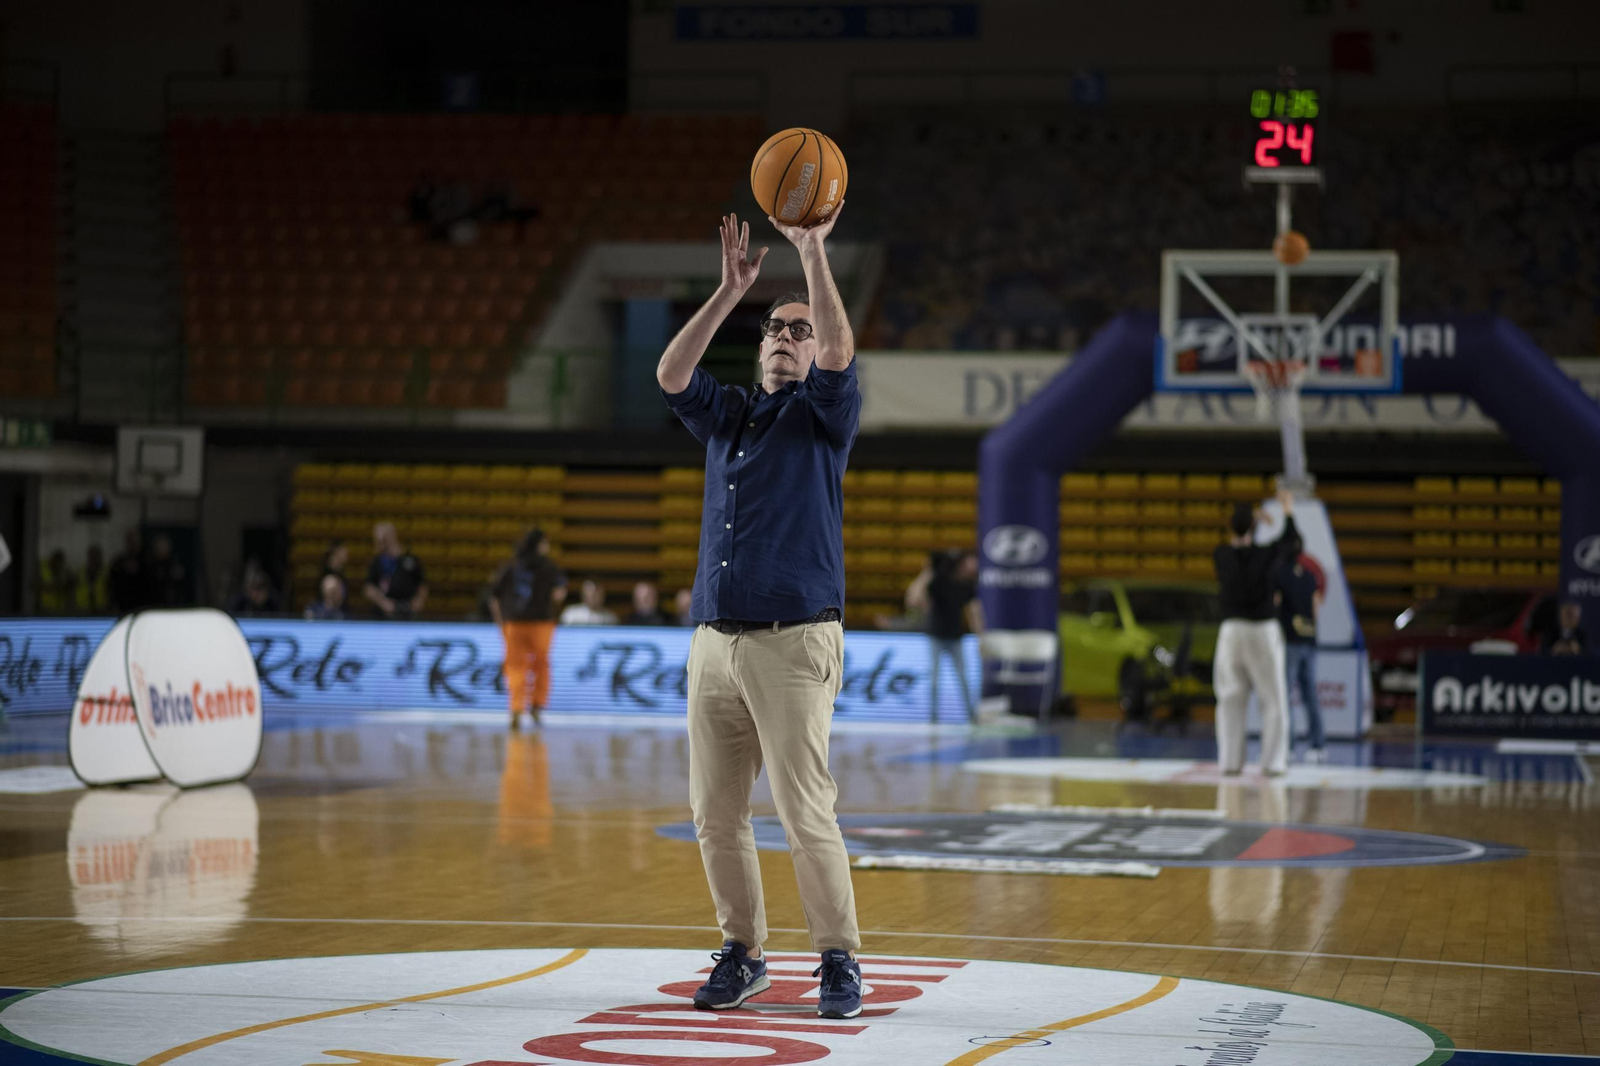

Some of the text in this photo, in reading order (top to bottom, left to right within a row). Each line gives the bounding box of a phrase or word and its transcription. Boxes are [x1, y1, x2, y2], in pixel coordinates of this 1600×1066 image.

[699, 8, 953, 38] FONDO SUR
[1255, 120, 1314, 167] 24
[779, 162, 816, 220] Wilson
[149, 679, 256, 728] BricoCentro
